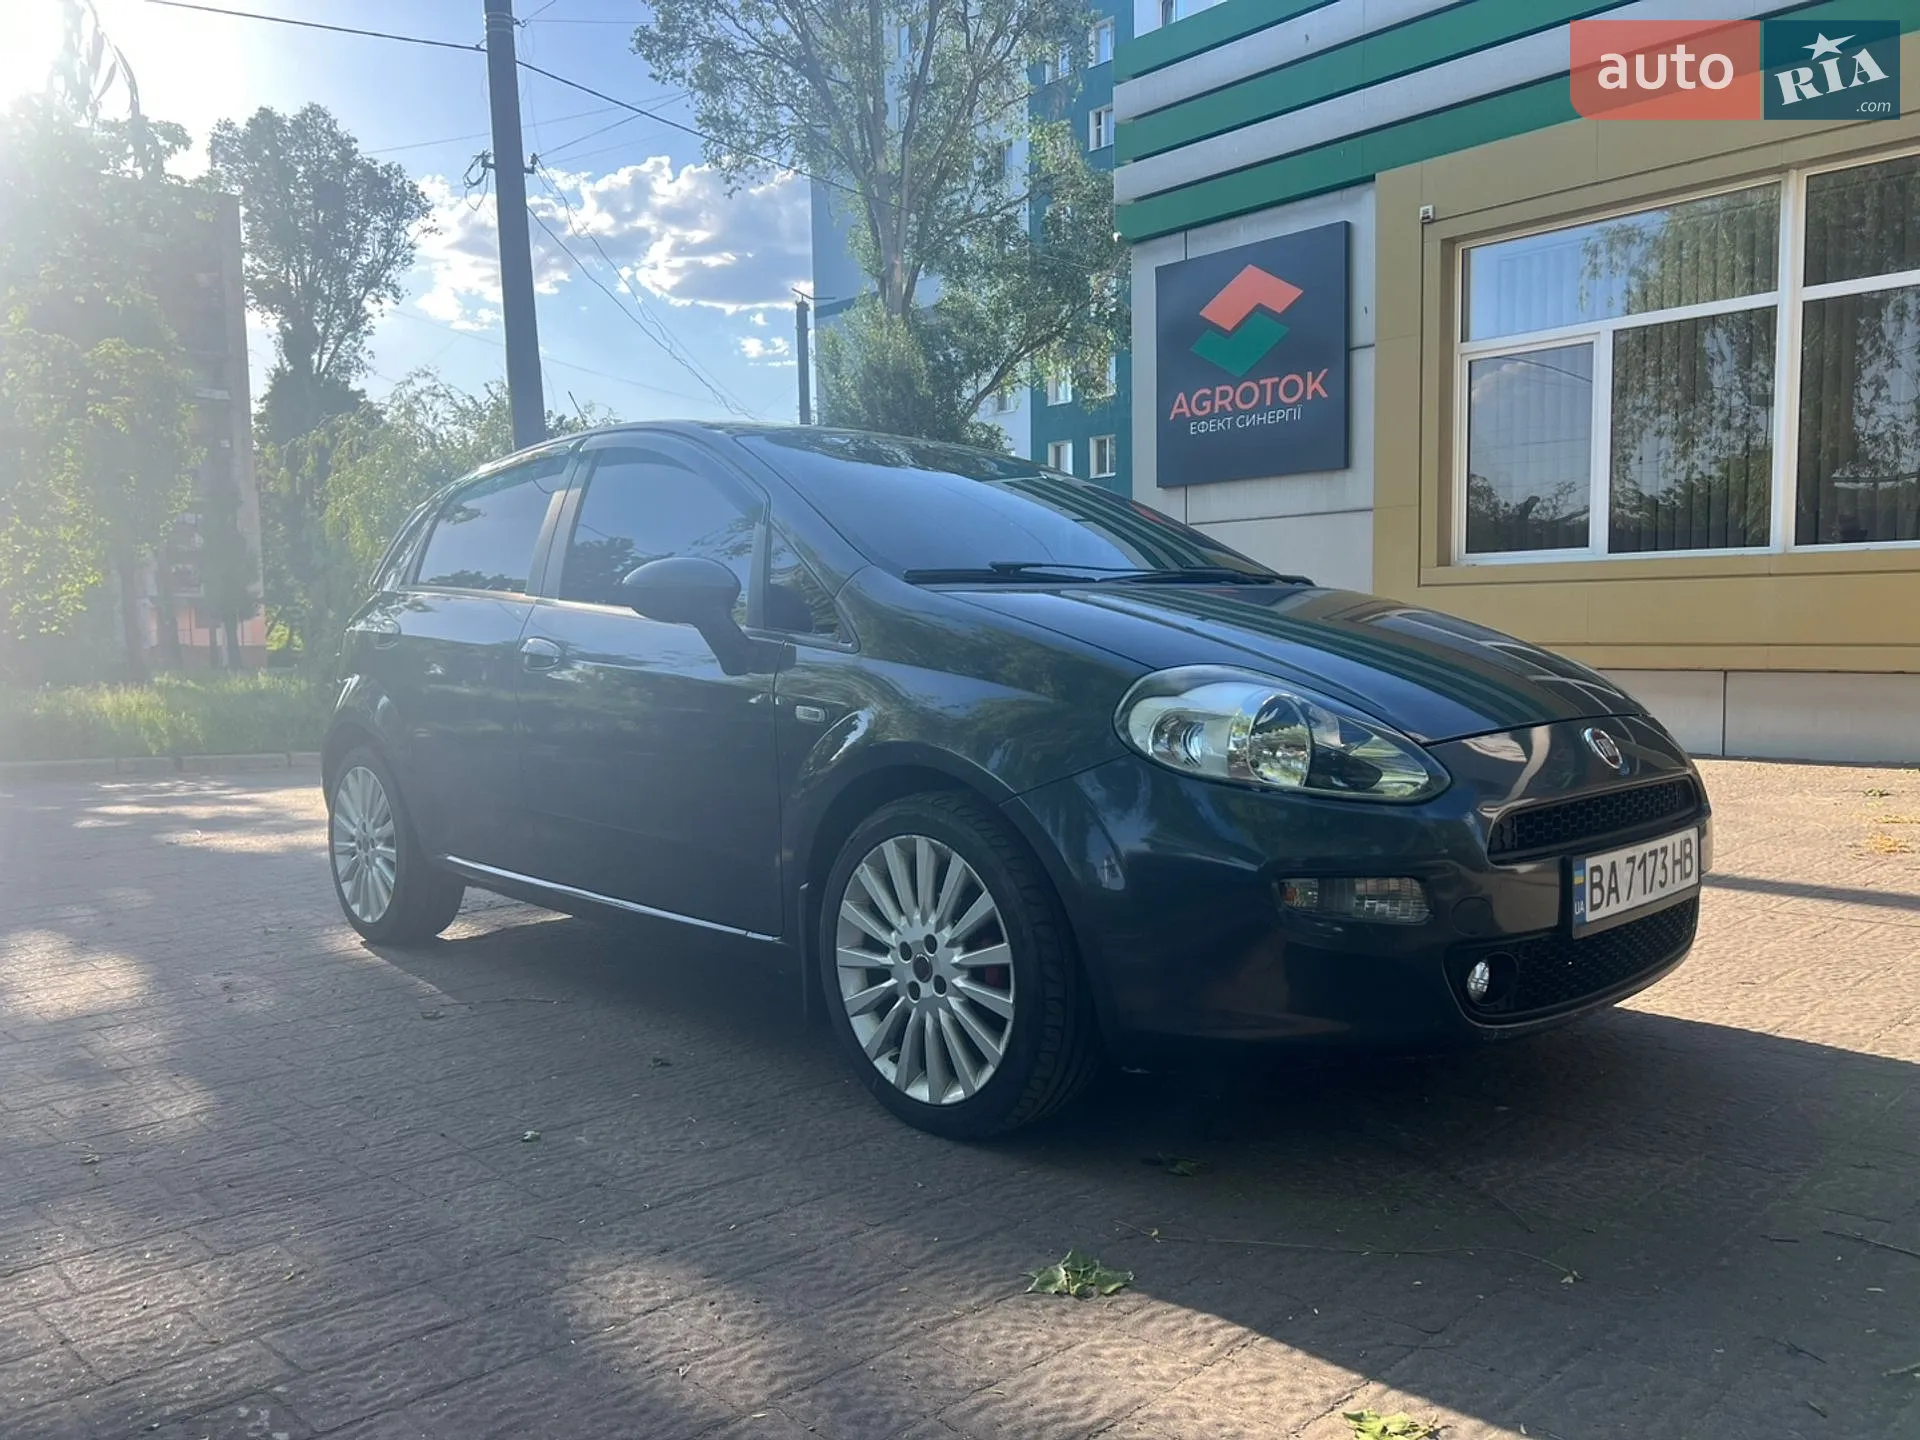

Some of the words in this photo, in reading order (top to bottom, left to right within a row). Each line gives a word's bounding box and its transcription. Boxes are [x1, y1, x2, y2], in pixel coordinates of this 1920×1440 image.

[1169, 368, 1329, 421] AGROTOK
[1190, 416, 1233, 435] ЕФЕКТ
[1236, 404, 1303, 428] СИНЕРГІЇ
[1589, 860, 1620, 912] BA
[1626, 845, 1669, 901] 7173
[1672, 838, 1694, 884] HB
